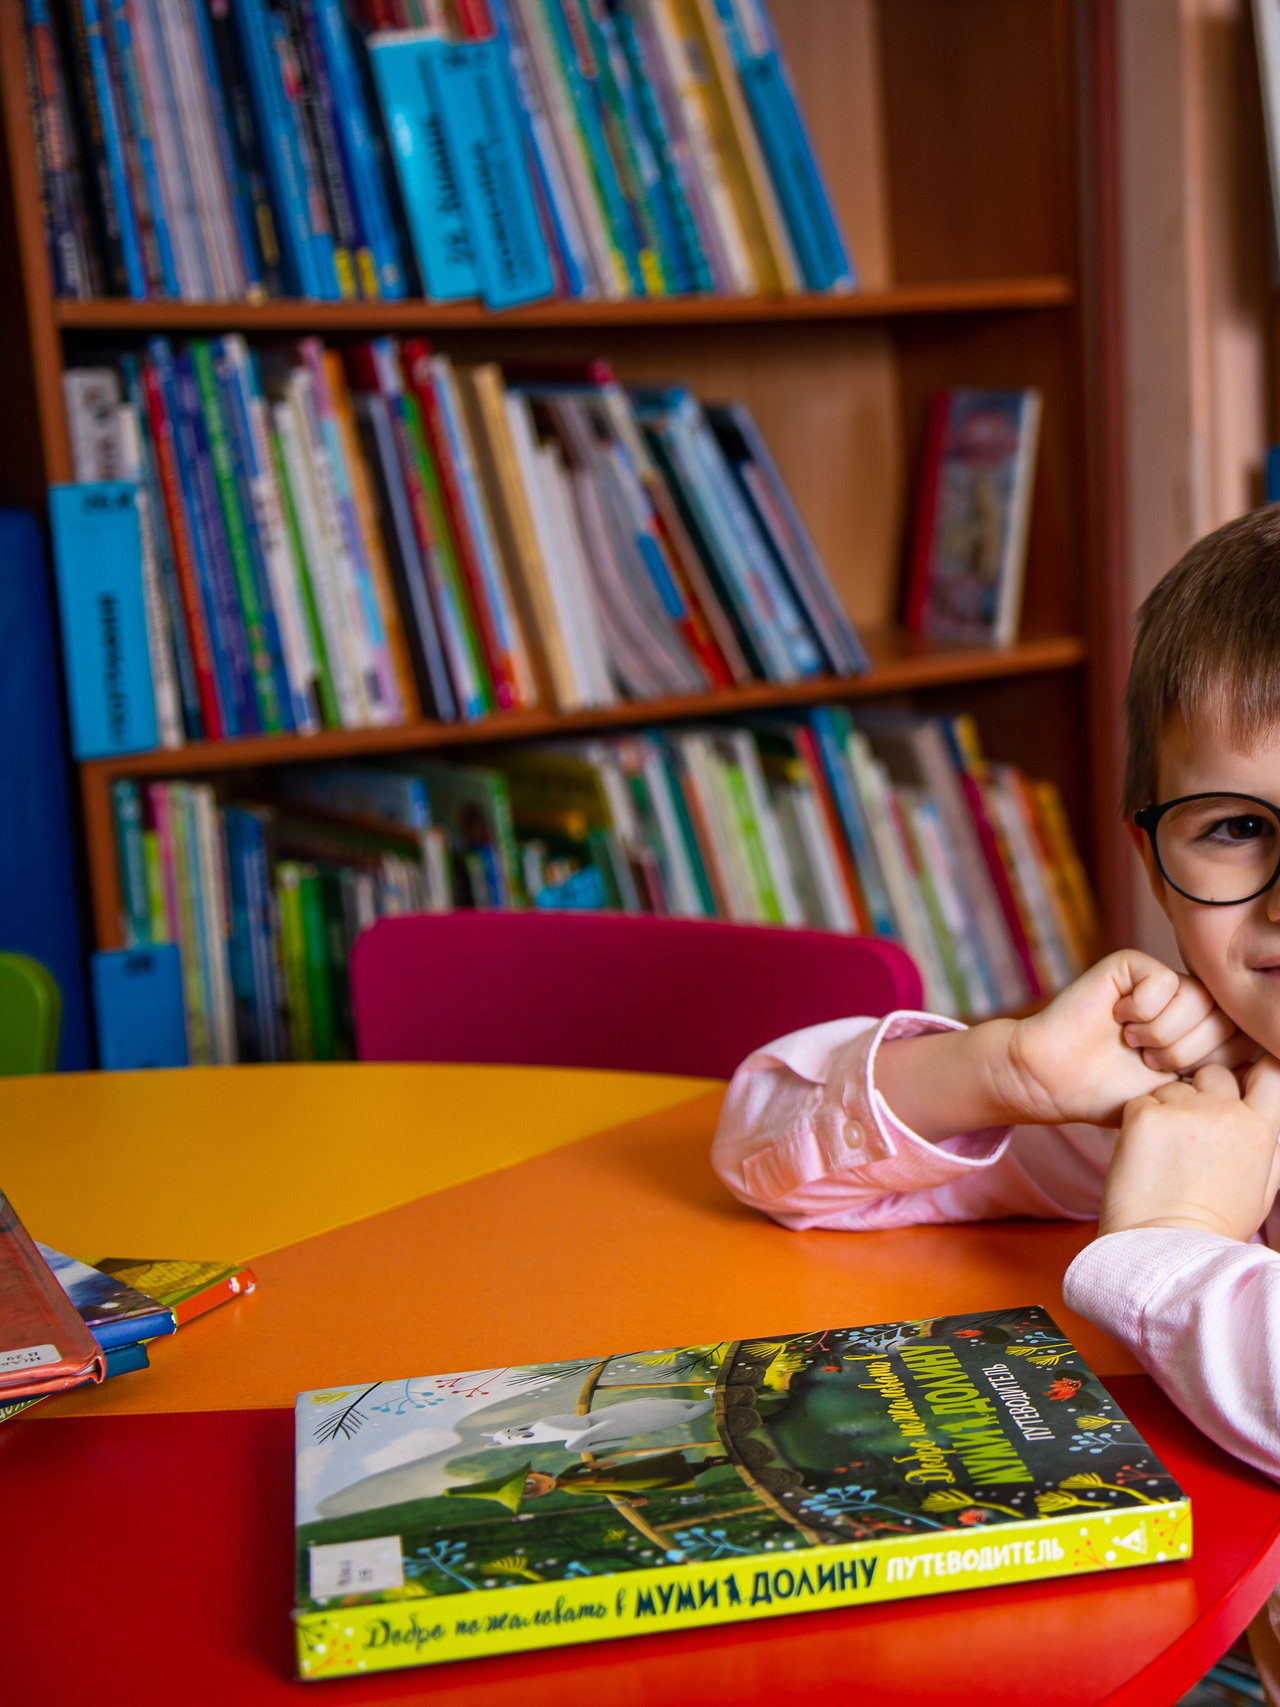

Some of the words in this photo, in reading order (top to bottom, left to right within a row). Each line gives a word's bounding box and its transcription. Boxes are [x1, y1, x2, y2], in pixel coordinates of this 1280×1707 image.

[858, 1361, 928, 1437] пожаловать
[896, 1345, 998, 1416] ДОЛИНУ
[981, 1363, 1056, 1442] ПУТЕВОДИТЕЛЬ
[893, 1439, 957, 1485] Добро
[947, 1429, 1034, 1486] МУМИ
[362, 1617, 447, 1652] Добро
[454, 1588, 607, 1636] пожаловать
[634, 1576, 719, 1619] МУМИ
[750, 1556, 878, 1607] ДОЛИНУ
[886, 1538, 1065, 1582] ПУТЕВОДИТЕЛЬ
